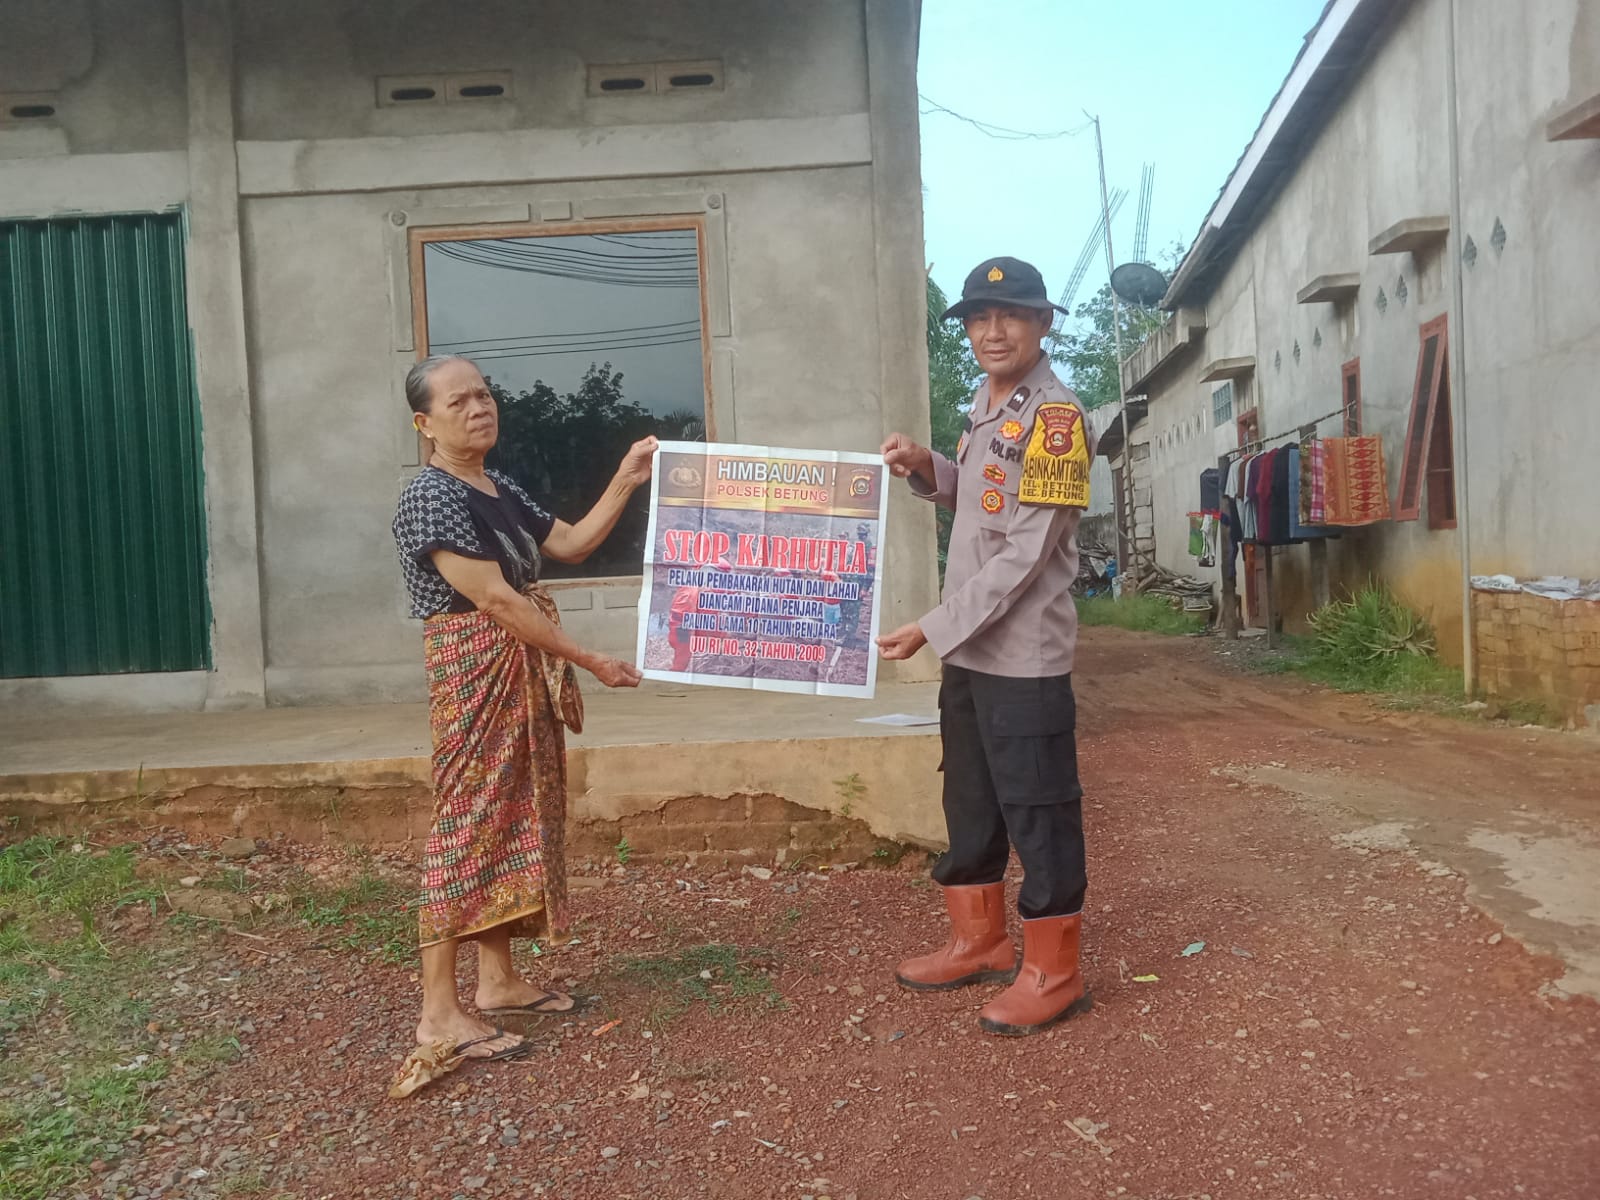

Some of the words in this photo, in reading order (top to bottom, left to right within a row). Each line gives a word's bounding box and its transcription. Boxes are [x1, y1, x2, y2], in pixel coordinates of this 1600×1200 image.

[717, 460, 825, 485] HIMBAUAN
[717, 484, 769, 498] POLSEK
[773, 487, 828, 501] BETUNG
[1041, 490, 1084, 500] BETUNG
[1042, 481, 1085, 492] BETUNG
[663, 530, 729, 565] STOP
[736, 534, 867, 574] KARHUTLA
[668, 569, 704, 587] PELAKU
[706, 572, 770, 593] PEMBAKARAN
[772, 577, 803, 595] HUTAN
[805, 580, 825, 597] DAN
[827, 582, 858, 600] LAHAN
[699, 593, 742, 612] DIANCAM
[745, 597, 779, 614] PIDANA
[781, 600, 824, 618] PENJARA
[683, 613, 716, 630] PALING
[718, 616, 744, 633] LAMA
[748, 619, 759, 634] 10
[762, 619, 792, 636] TAHUN
[795, 621, 836, 640] PENJARA
[691, 636, 705, 653] UU
[708, 638, 720, 654] RI
[723, 640, 741, 656] NO.
[744, 640, 758, 656] 32
[761, 642, 796, 660] TAHUN
[799, 645, 825, 662] 2009
